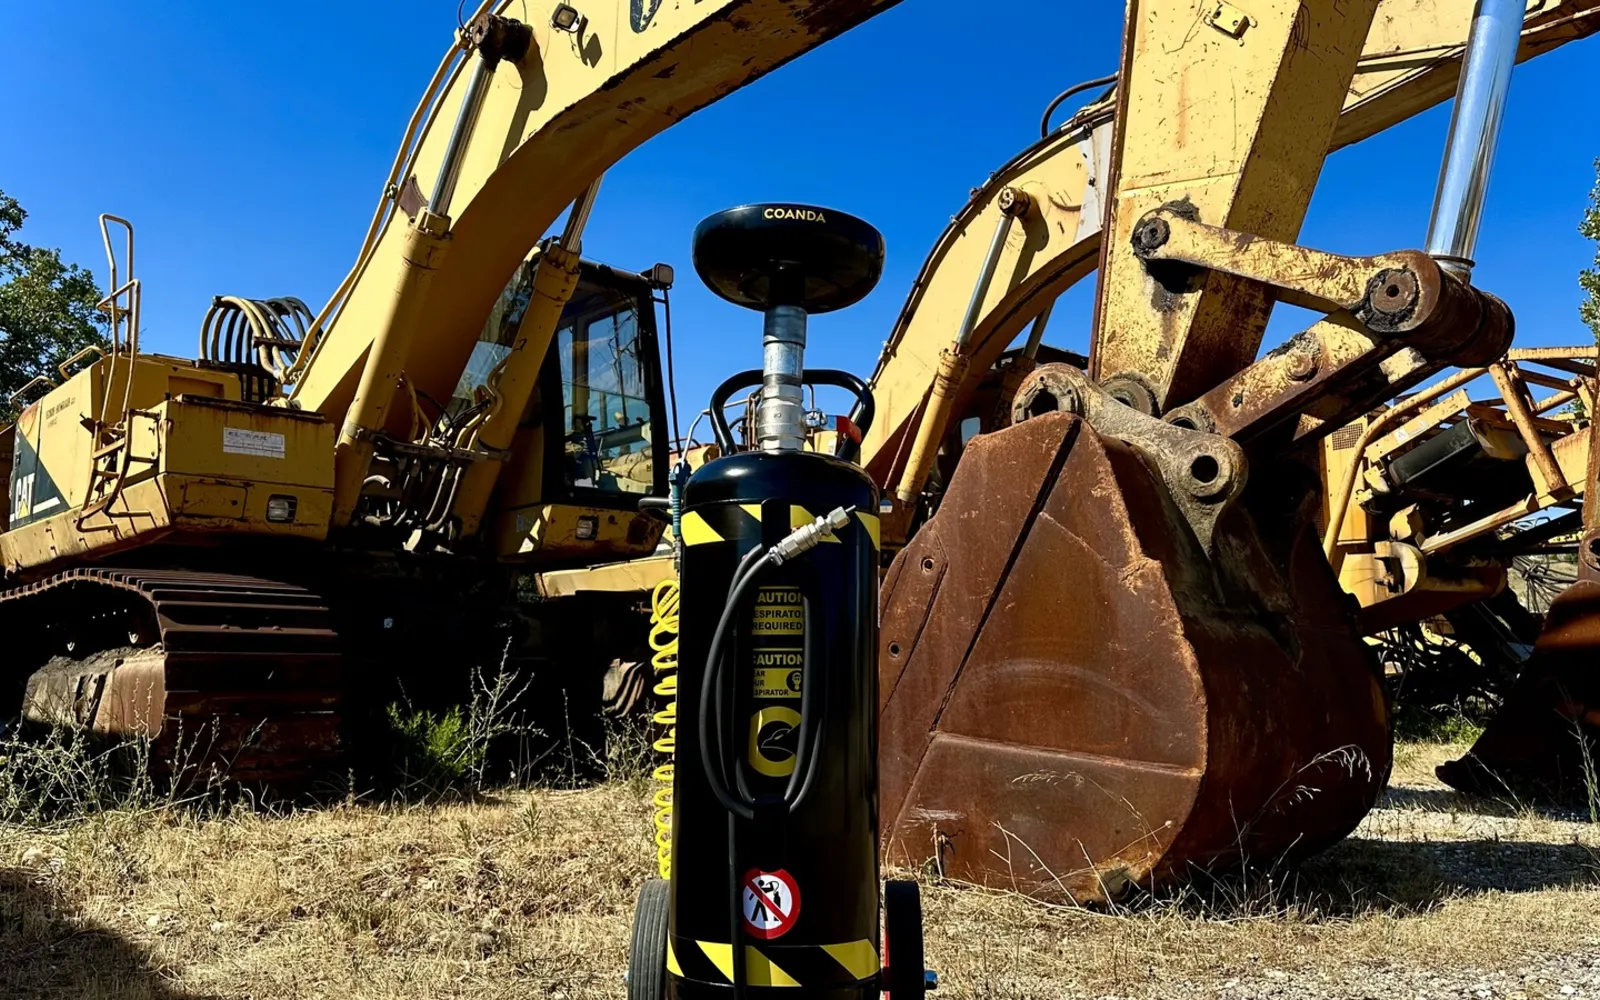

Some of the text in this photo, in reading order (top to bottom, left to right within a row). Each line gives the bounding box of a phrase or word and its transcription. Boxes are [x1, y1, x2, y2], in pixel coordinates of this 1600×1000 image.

[763, 208, 826, 223] COANDA
[15, 473, 35, 520] CAT
[757, 591, 802, 603] AUTIO
[755, 609, 801, 618] ESPIRATO
[752, 621, 803, 630] REQUIRED
